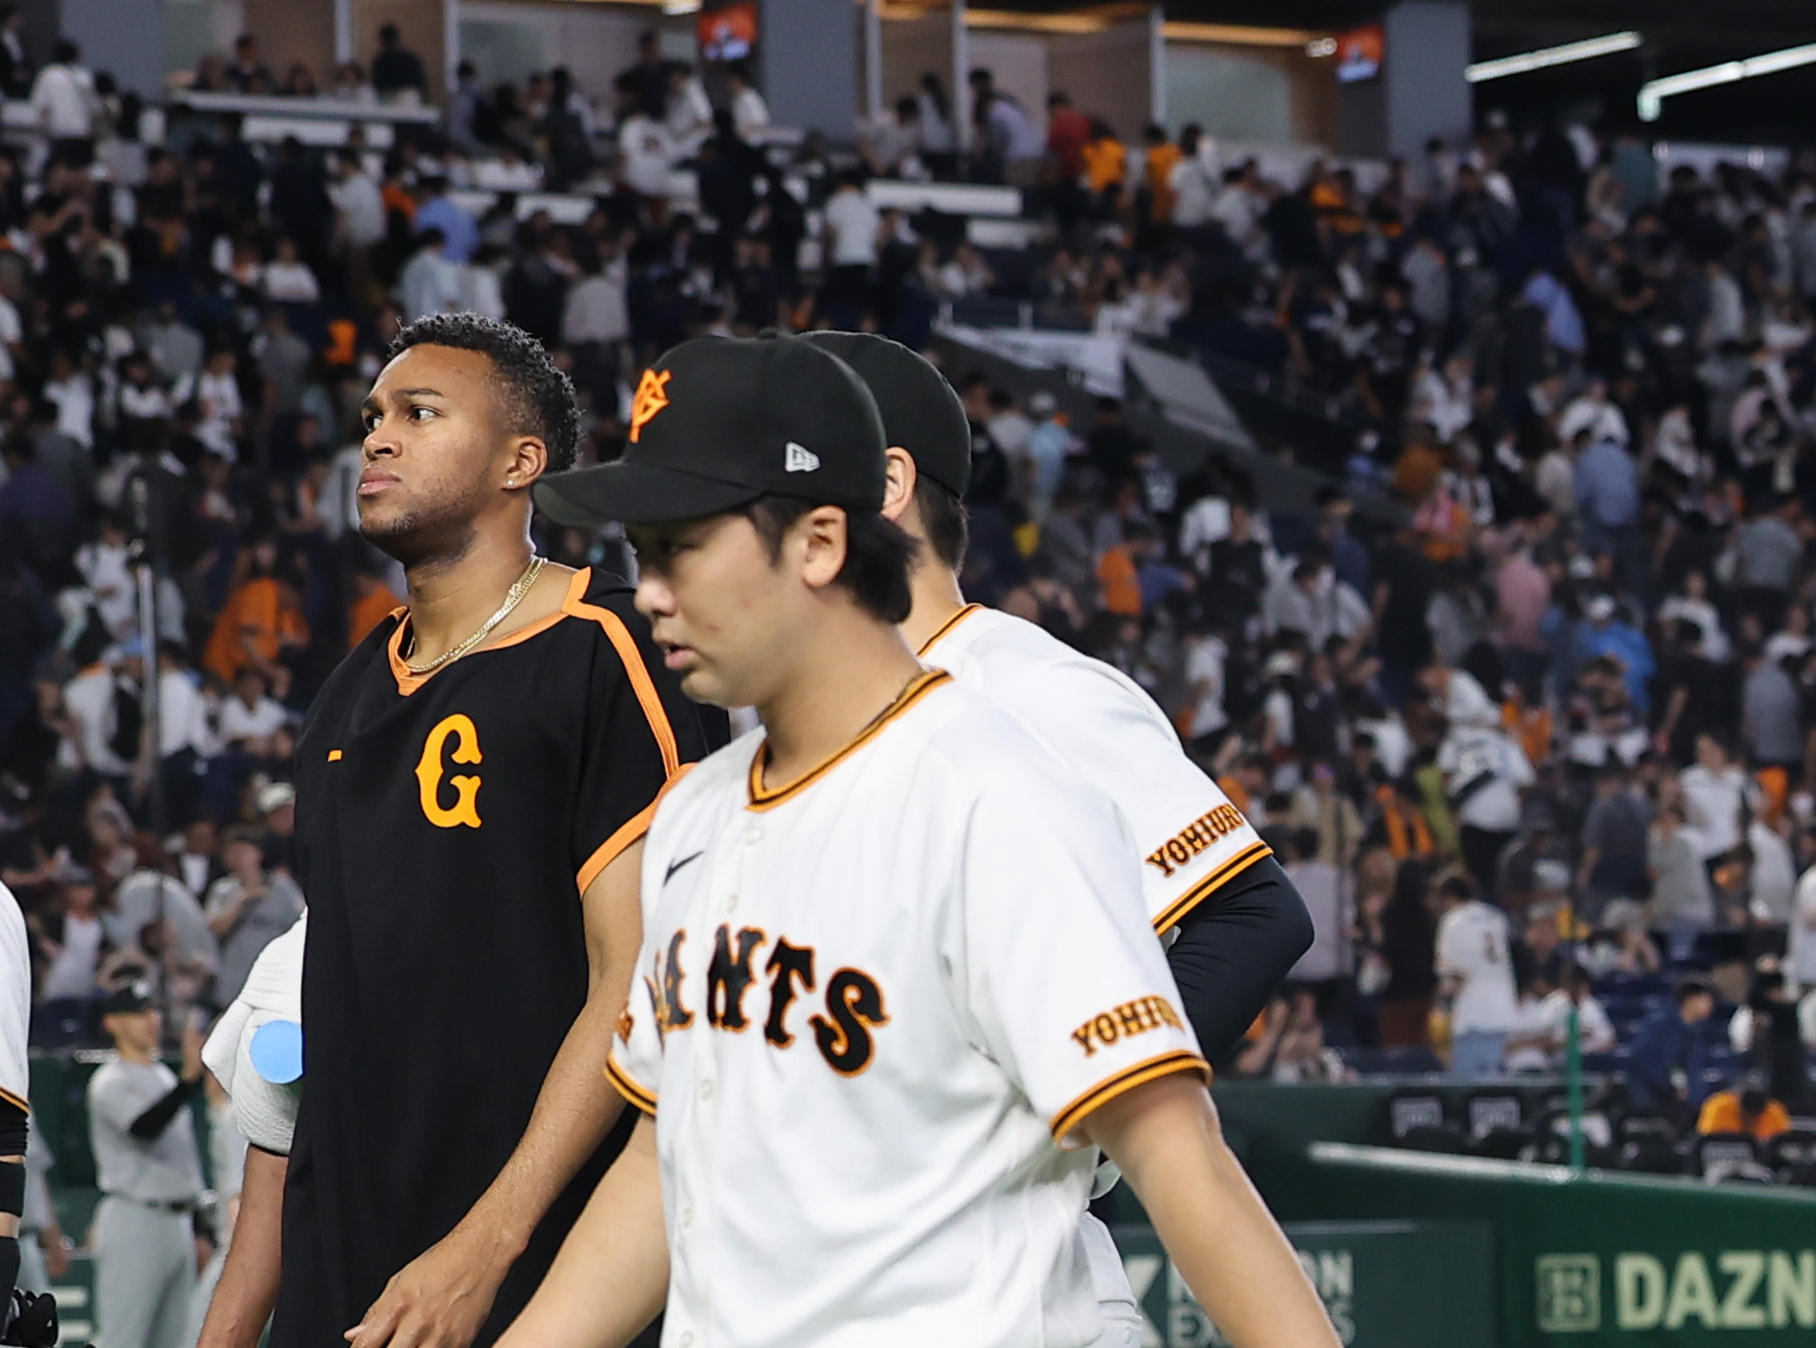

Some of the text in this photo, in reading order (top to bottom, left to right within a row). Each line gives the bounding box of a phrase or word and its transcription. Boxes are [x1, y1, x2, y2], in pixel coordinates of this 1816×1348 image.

[413, 712, 484, 829] G
[1144, 802, 1245, 878] YOMIUR
[644, 921, 891, 1079] ANTS
